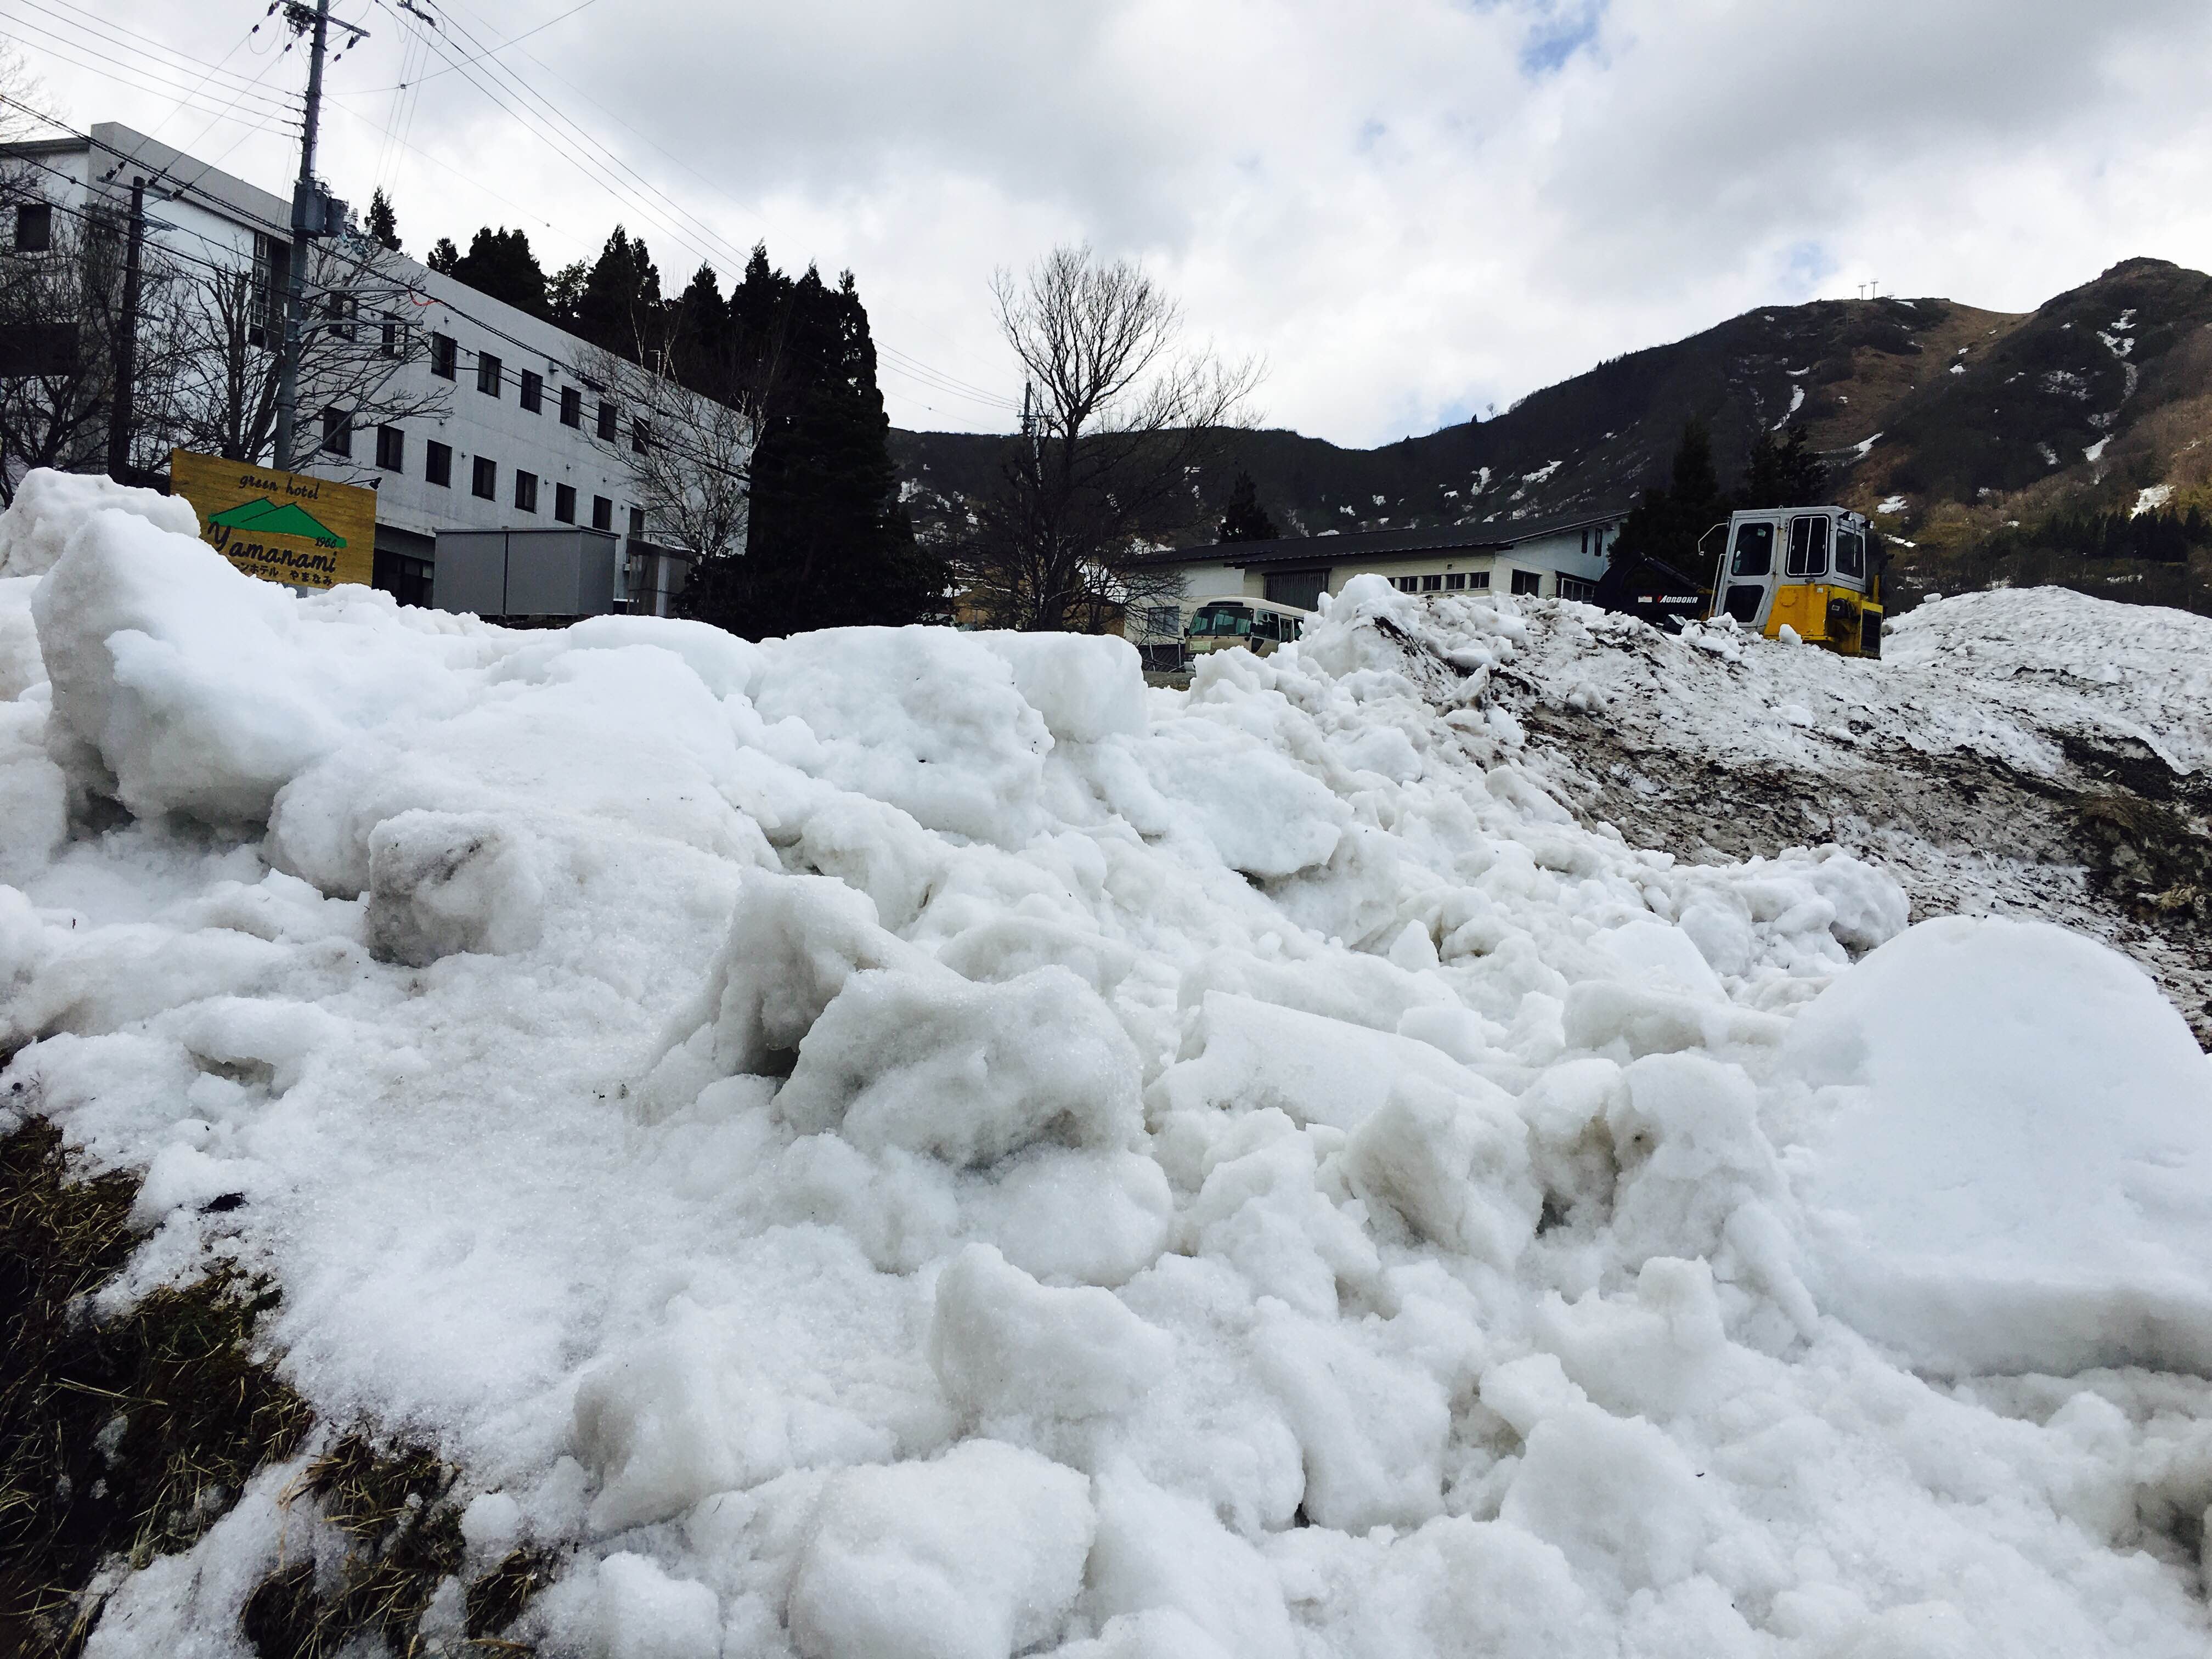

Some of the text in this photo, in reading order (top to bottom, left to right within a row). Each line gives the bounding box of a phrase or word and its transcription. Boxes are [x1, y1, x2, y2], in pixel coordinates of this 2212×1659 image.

[239, 475, 320, 500] green hotel
[207, 521, 338, 573] Yamanami
[289, 569, 332, 585] やまなみ
